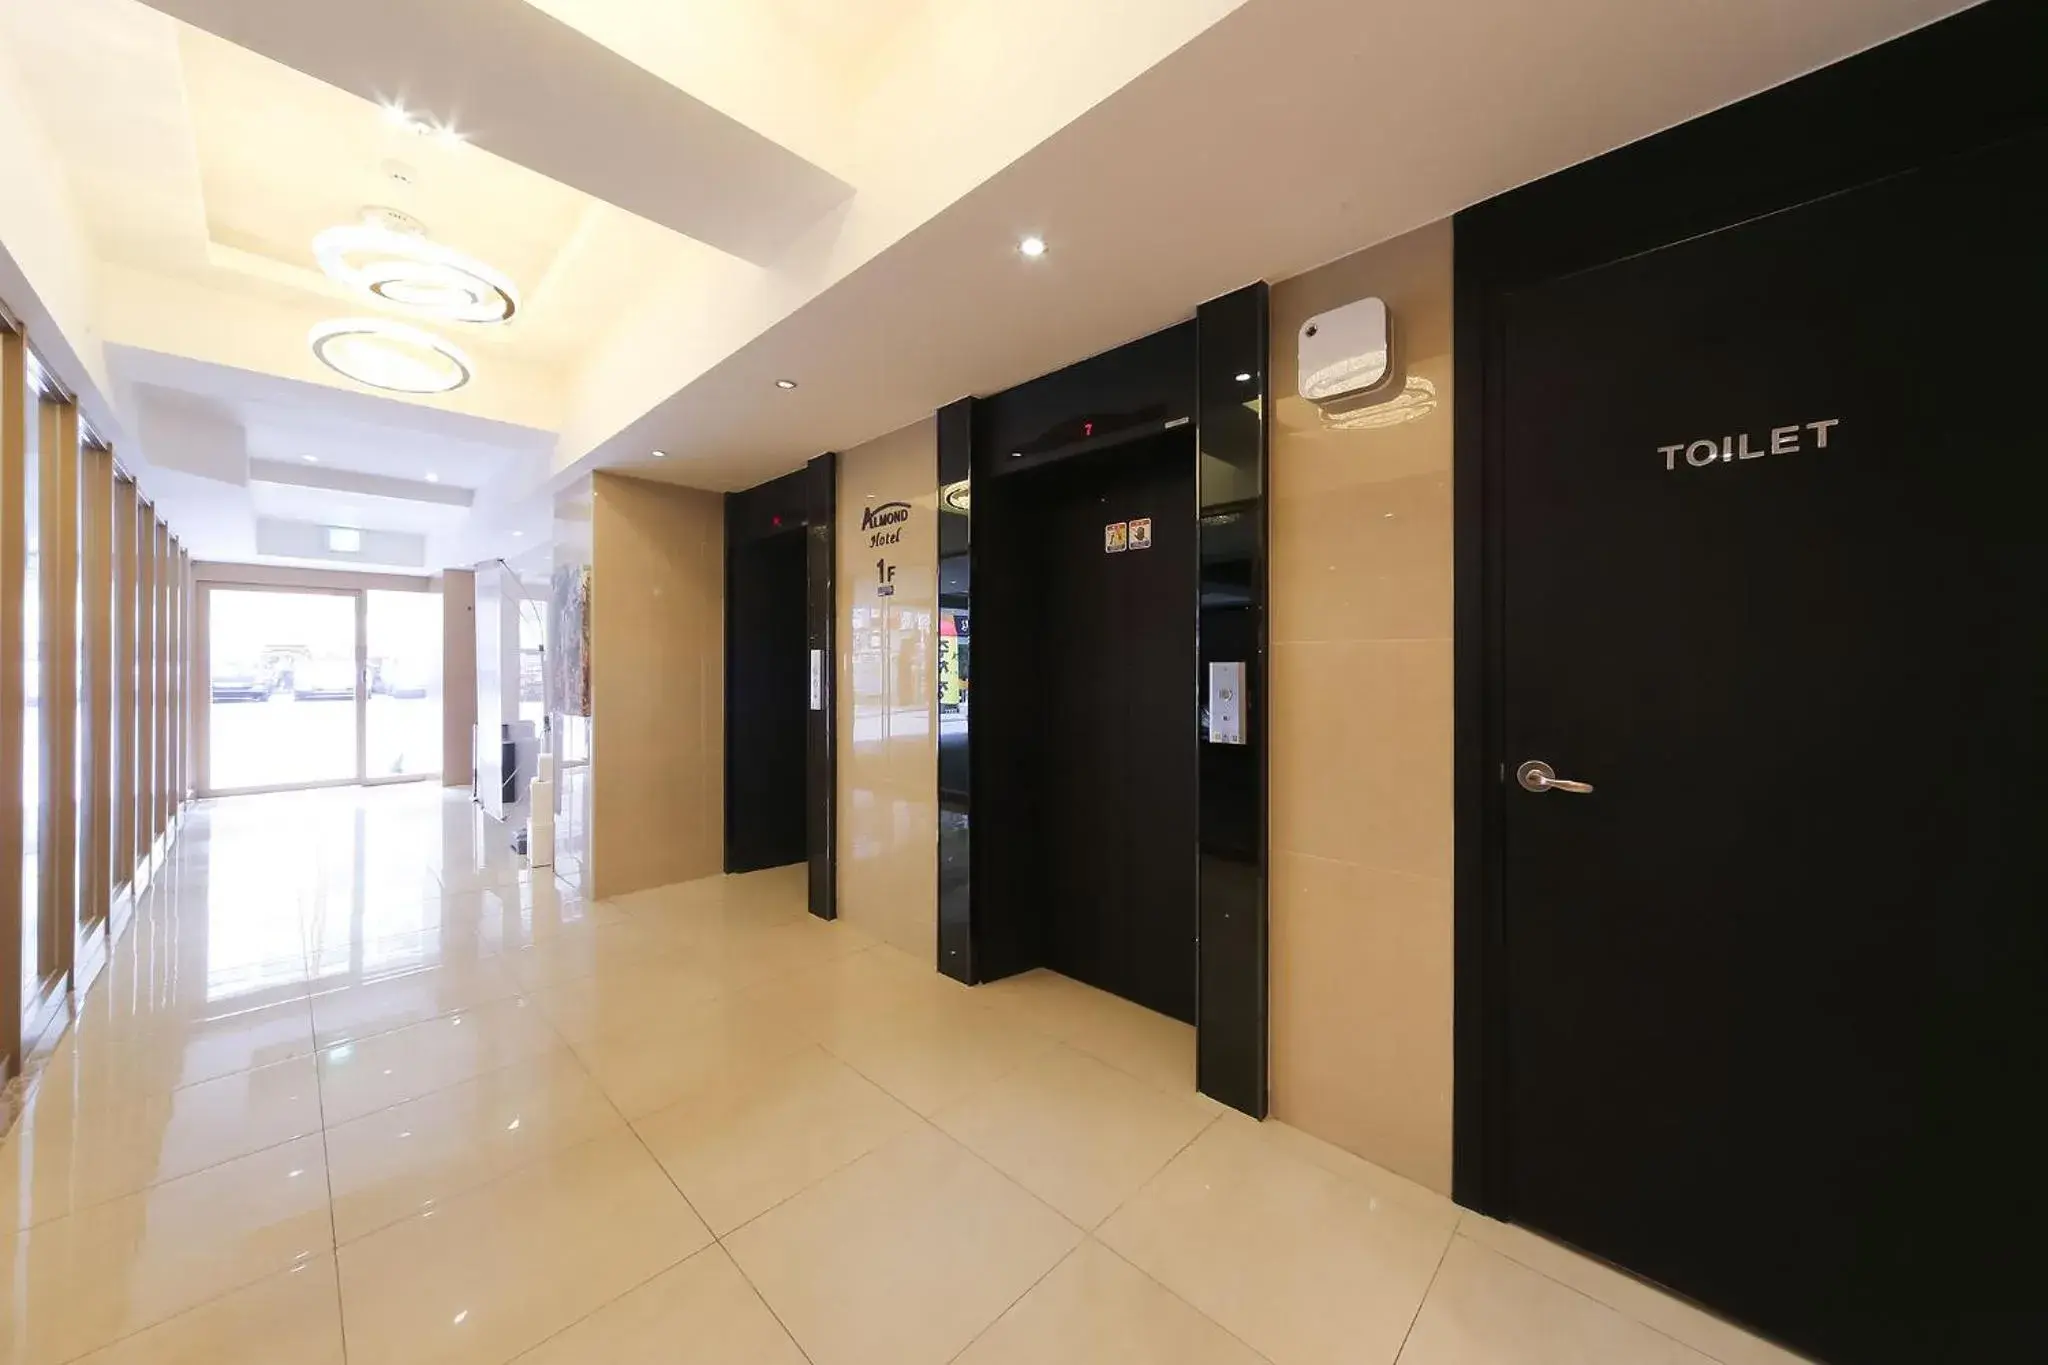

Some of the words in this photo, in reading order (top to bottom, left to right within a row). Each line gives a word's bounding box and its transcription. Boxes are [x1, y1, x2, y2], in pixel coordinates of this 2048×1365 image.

[1084, 423, 1093, 436] 7
[1657, 418, 1840, 471] TOILET
[861, 503, 911, 531] ALMOND
[869, 526, 902, 548] Hotel
[876, 558, 896, 583] 1F
